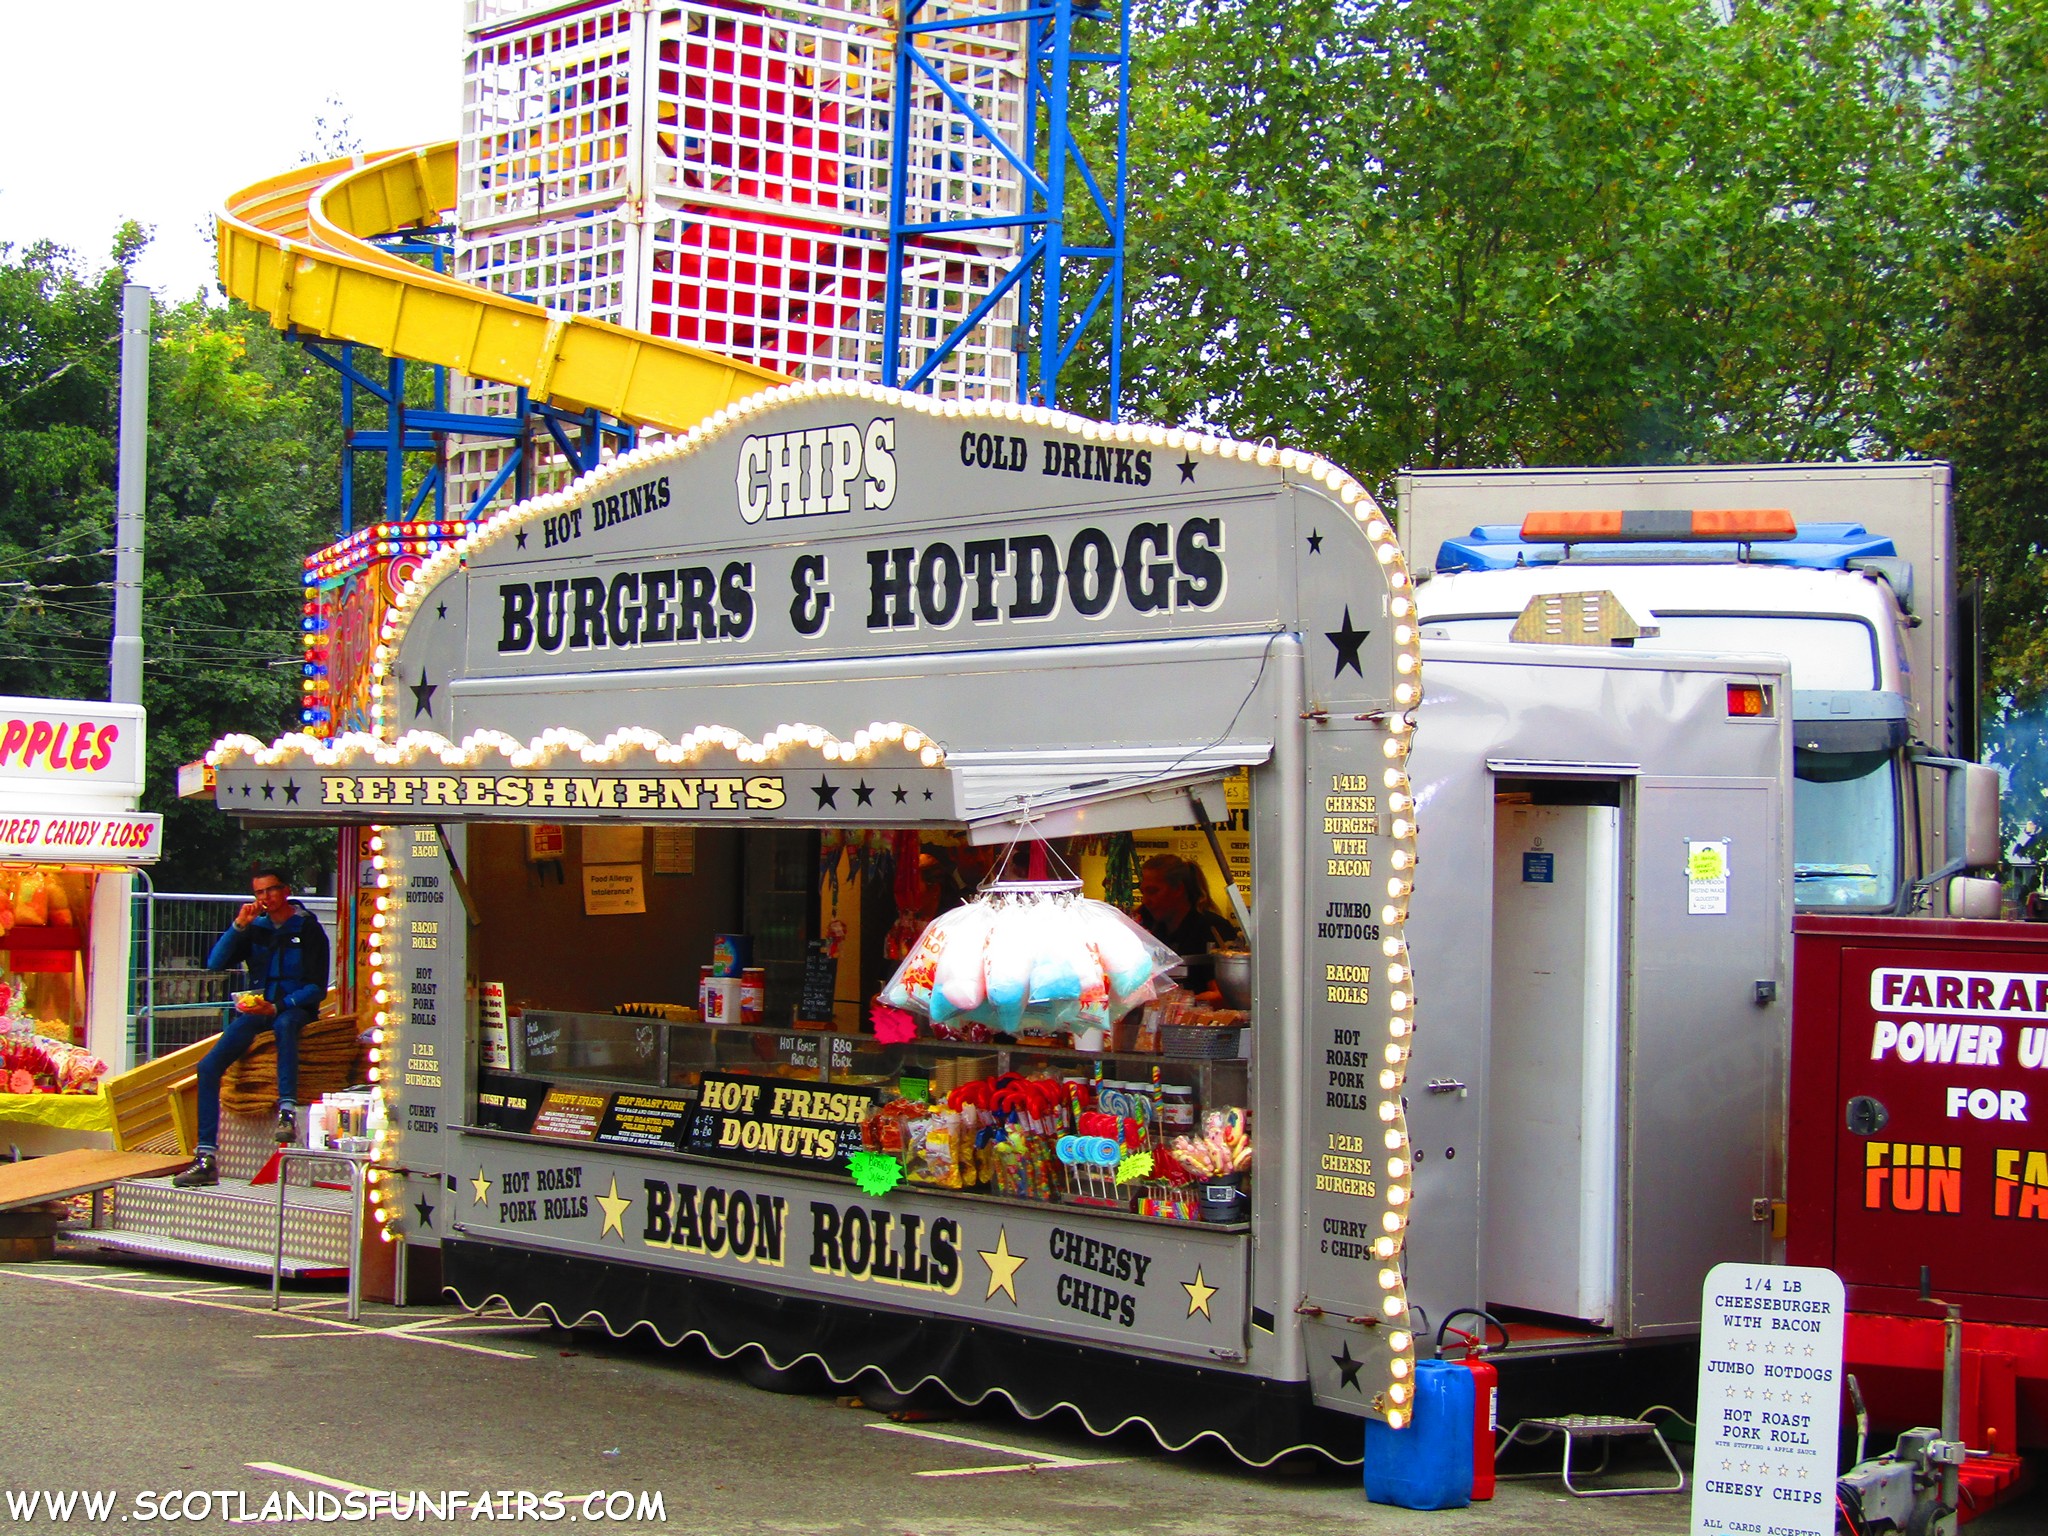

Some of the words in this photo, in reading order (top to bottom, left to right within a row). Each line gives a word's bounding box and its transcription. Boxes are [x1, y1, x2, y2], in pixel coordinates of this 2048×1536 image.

[960, 430, 1028, 473] COLD
[1042, 440, 1153, 487] DRINKS
[735, 416, 897, 525] CHIPS
[543, 512, 582, 549] HOT
[592, 476, 671, 531] DRINKS
[497, 561, 756, 658] BURGERS
[788, 553, 835, 640] &
[866, 516, 1227, 634] HOTDOGS
[1332, 773, 1368, 794] 1/4LB
[321, 776, 787, 811] REFRESHMENTS
[1325, 796, 1376, 813] CHEESE
[44, 820, 101, 846] CANDY
[102, 822, 154, 848] FLOSS
[414, 830, 436, 842] WITH
[411, 844, 438, 857] BACON
[1332, 839, 1368, 856] WITH
[1327, 859, 1372, 877] BACON
[410, 876, 439, 888] JUMBO
[609, 874, 633, 884] Allergy
[405, 891, 444, 904] HOTDOGS
[591, 887, 634, 896] Intolerance?
[1326, 902, 1371, 919] JUMBO
[411, 921, 438, 934] BACON
[1318, 923, 1380, 941] HOTDOGS
[411, 936, 437, 949] ROLLS
[415, 968, 432, 980] HOT
[1326, 964, 1370, 983] BACON
[411, 983, 437, 996] ROAST
[1327, 986, 1369, 1005] ROLLS
[413, 998, 435, 1011] PORK
[411, 1013, 437, 1026] ROLLS
[780, 1036, 795, 1050] HOT
[833, 1038, 853, 1053] BBQ
[1334, 1029, 1360, 1046] HOT
[1871, 1020, 2004, 1067] POWER
[2017, 1027, 2048, 1070] U
[407, 1058, 439, 1072] CHEESE
[1326, 1050, 1368, 1068] ROAST
[405, 1072, 442, 1088] BURGERS
[1329, 1071, 1365, 1089] PORK
[507, 1096, 527, 1110] PEAS
[549, 1093, 578, 1104] DIRTY
[577, 1095, 604, 1108] FRIES
[617, 1095, 635, 1106] HOT
[635, 1097, 663, 1109] ROAST
[662, 1099, 686, 1111] PORK
[701, 1080, 760, 1115] HOT
[770, 1087, 871, 1127] FRESH
[1326, 1092, 1367, 1111] ROLLS
[1946, 1087, 2028, 1123] FOR
[408, 1105, 436, 1118] CURRY
[413, 1120, 438, 1134] CHIPS
[645, 1125, 663, 1133] PORK
[718, 1117, 837, 1161] DONUTS
[1328, 1133, 1363, 1153] 1/2LB
[1321, 1154, 1371, 1176] CHEESE
[502, 1172, 530, 1194] HOT
[537, 1166, 583, 1191] ROAST
[1315, 1174, 1376, 1198] BURGERS
[1865, 1141, 1962, 1214] FUN
[499, 1198, 538, 1224] PORK
[543, 1195, 588, 1220] ROLLS
[643, 1178, 790, 1269] BACON
[809, 1201, 964, 1296] ROLLS
[1323, 1218, 1368, 1239] CURRY
[1049, 1227, 1151, 1288] CHEESY
[1320, 1240, 1328, 1254] &
[1331, 1240, 1371, 1261] CHIPS
[1745, 1278, 1772, 1292] 1/4
[1782, 1280, 1802, 1293] LB
[1056, 1273, 1136, 1328] CHIPS
[1715, 1295, 1831, 1315] CHEESEBURGER
[1723, 1315, 1762, 1329] WITH
[1772, 1318, 1821, 1333] BACON
[1708, 1360, 1755, 1375] JUMBO
[1764, 1365, 1833, 1382] HOTDOGS
[1723, 1408, 1752, 1422] HOT
[1762, 1412, 1811, 1428] ROAST
[1723, 1426, 1761, 1440] PORK
[1770, 1429, 1810, 1445] ROLL
[1733, 1442, 1764, 1450] STUFFING
[1774, 1446, 1794, 1454] APPLE
[1796, 1448, 1817, 1456] SAUCE
[1705, 1480, 1764, 1498] CHEESY
[1773, 1488, 1822, 1504] CHIPS
[1703, 1518, 1723, 1529] ALL
[1729, 1521, 1762, 1533] CARDS
[1768, 1526, 1821, 1536] ACCEPTED
